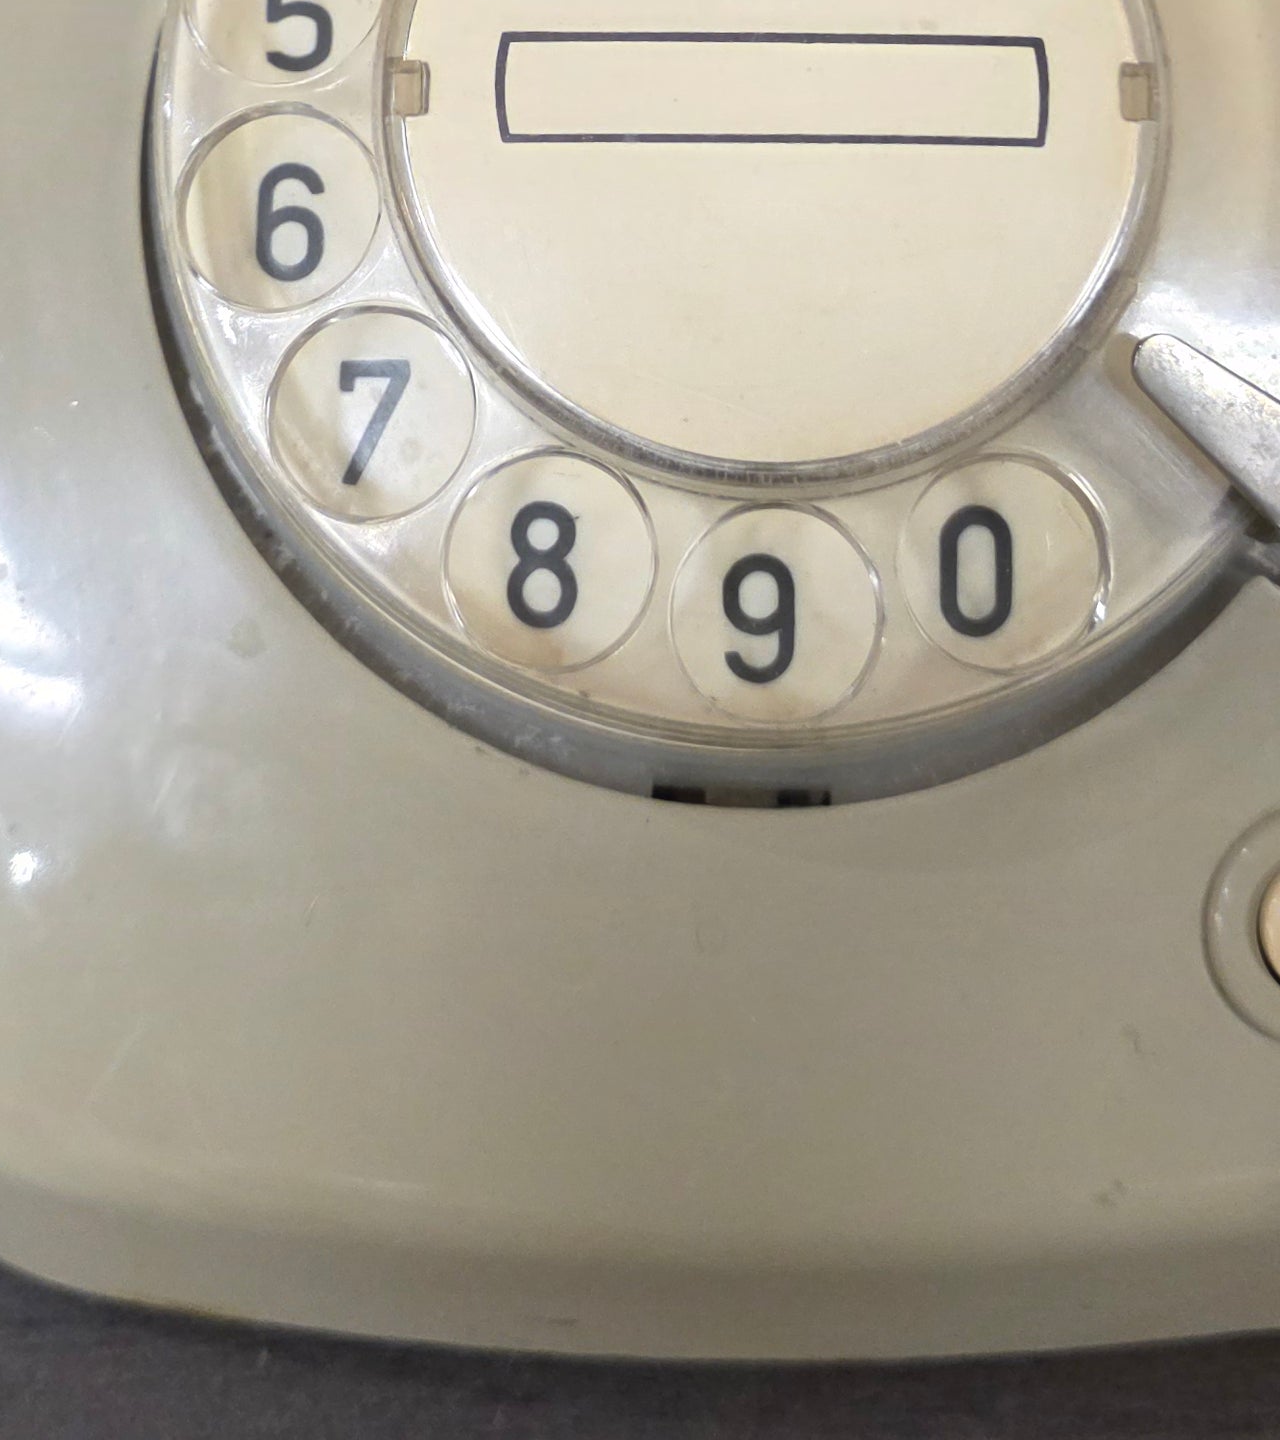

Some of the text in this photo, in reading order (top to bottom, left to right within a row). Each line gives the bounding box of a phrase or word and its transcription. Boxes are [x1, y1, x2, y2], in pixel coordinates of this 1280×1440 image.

[254, 163, 324, 282] 6
[338, 360, 411, 486] 7
[507, 502, 578, 631] 8
[723, 554, 795, 685] 9
[940, 505, 1013, 638] 0
